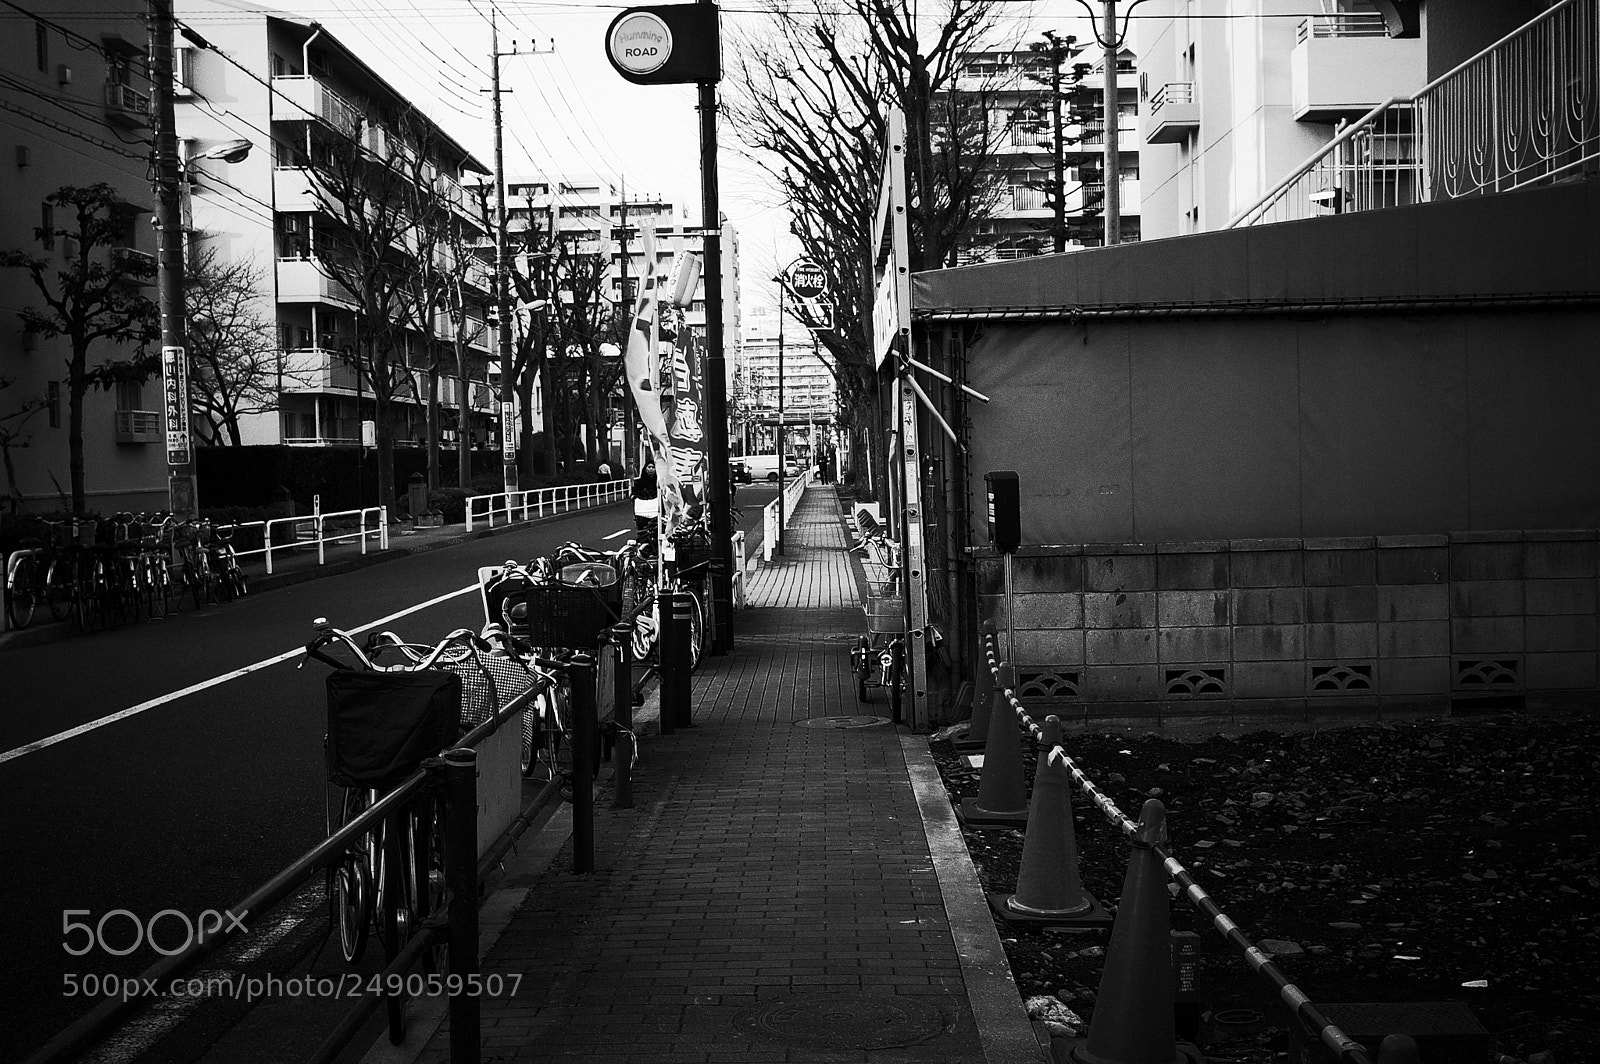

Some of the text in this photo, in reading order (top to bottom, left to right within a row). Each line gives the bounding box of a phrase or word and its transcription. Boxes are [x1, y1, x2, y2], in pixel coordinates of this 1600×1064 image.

[619, 30, 663, 43] Humming
[625, 47, 658, 57] ROAD
[794, 273, 824, 288] 消火栓
